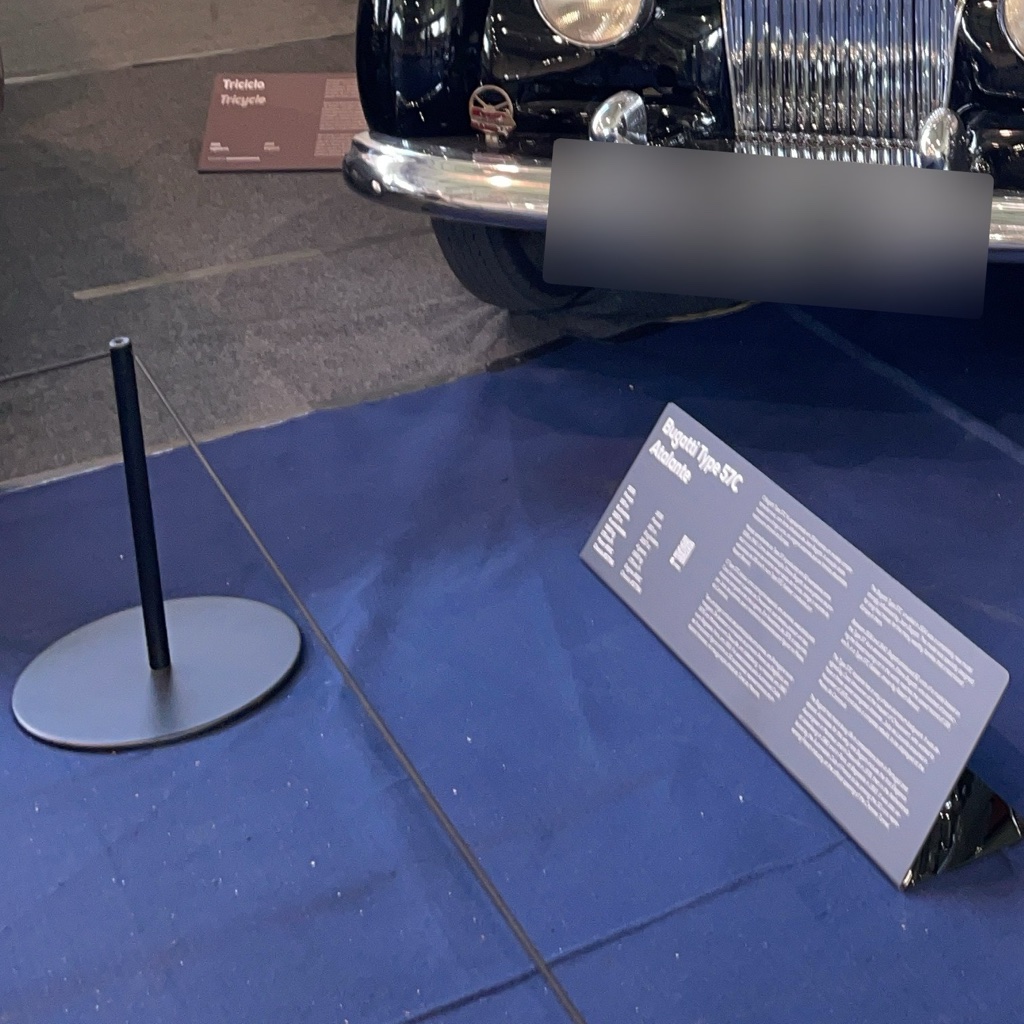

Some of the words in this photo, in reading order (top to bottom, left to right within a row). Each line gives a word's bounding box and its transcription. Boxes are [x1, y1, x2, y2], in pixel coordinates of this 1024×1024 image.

[222, 78, 266, 91] Triciclo
[220, 93, 267, 108] Tricycle
[648, 439, 692, 485] Atalante
[661, 416, 701, 459] Bugatti
[696, 444, 721, 477] Type
[719, 463, 744, 494] 57C
